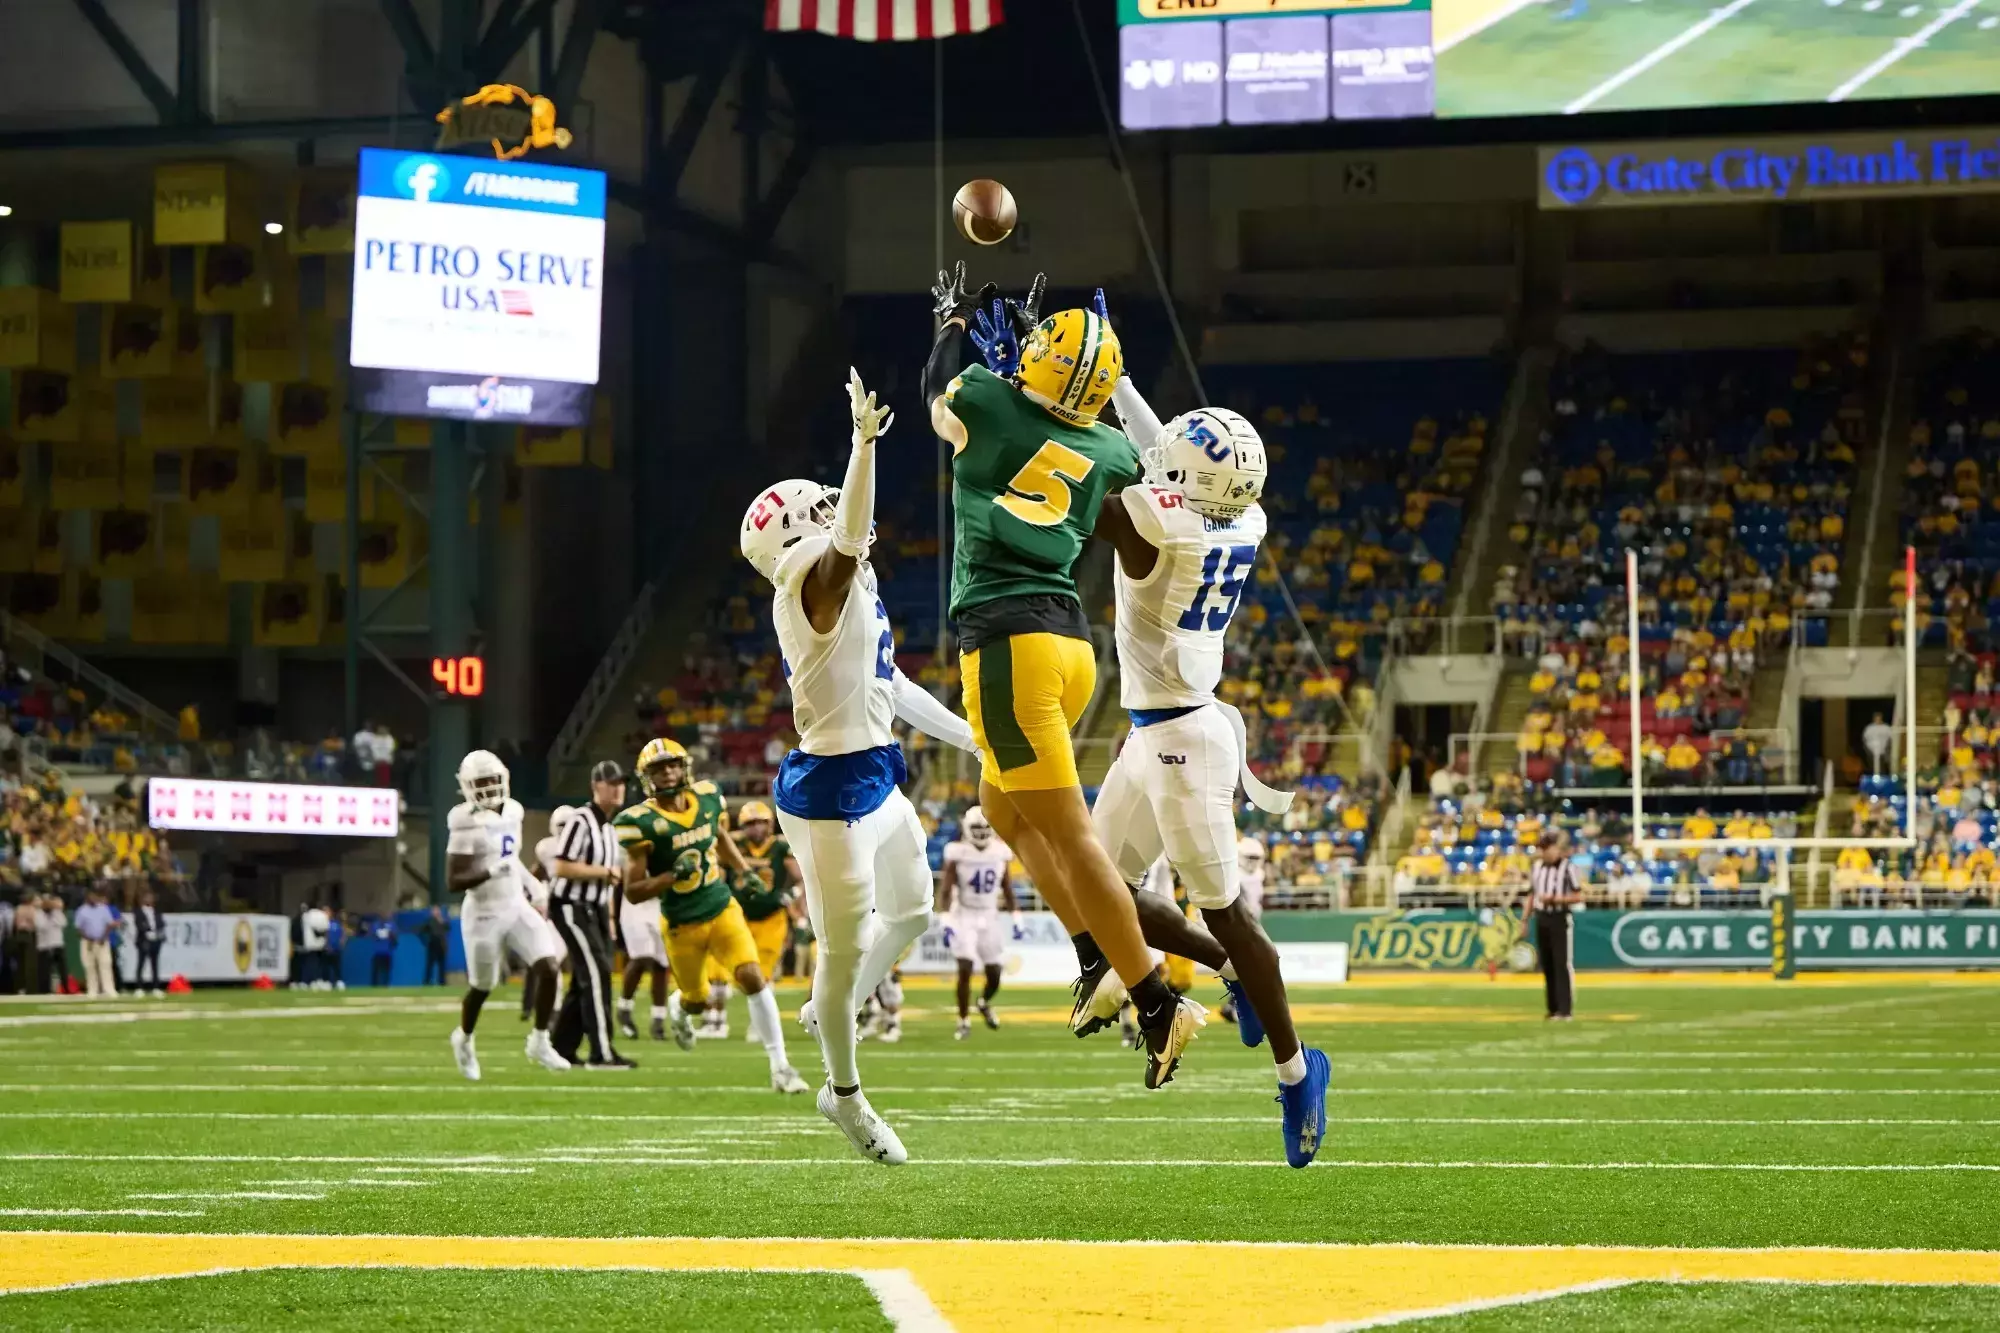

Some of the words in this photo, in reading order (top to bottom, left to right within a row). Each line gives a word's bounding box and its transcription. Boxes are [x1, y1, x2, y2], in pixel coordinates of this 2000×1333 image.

[1606, 153, 1700, 192] Gate
[1711, 147, 1799, 198] City
[1805, 140, 1920, 187] Bank
[1930, 138, 2000, 181] Fie
[365, 237, 480, 279] PETRO
[496, 248, 596, 290] SERVE
[441, 284, 500, 313] USA
[1068, 360, 1090, 401] BISON
[1083, 392, 1099, 407] 5
[1048, 404, 1080, 422] NDSU
[991, 438, 1096, 526] 5
[749, 490, 786, 532] 21
[1176, 544, 1256, 632] 15
[432, 656, 483, 697] 40
[968, 868, 997, 895] 48
[1351, 925, 1474, 963] NDSU
[1639, 924, 1732, 950] GATE
[1746, 924, 1834, 950] CTY
[1849, 924, 1949, 950] BANK
